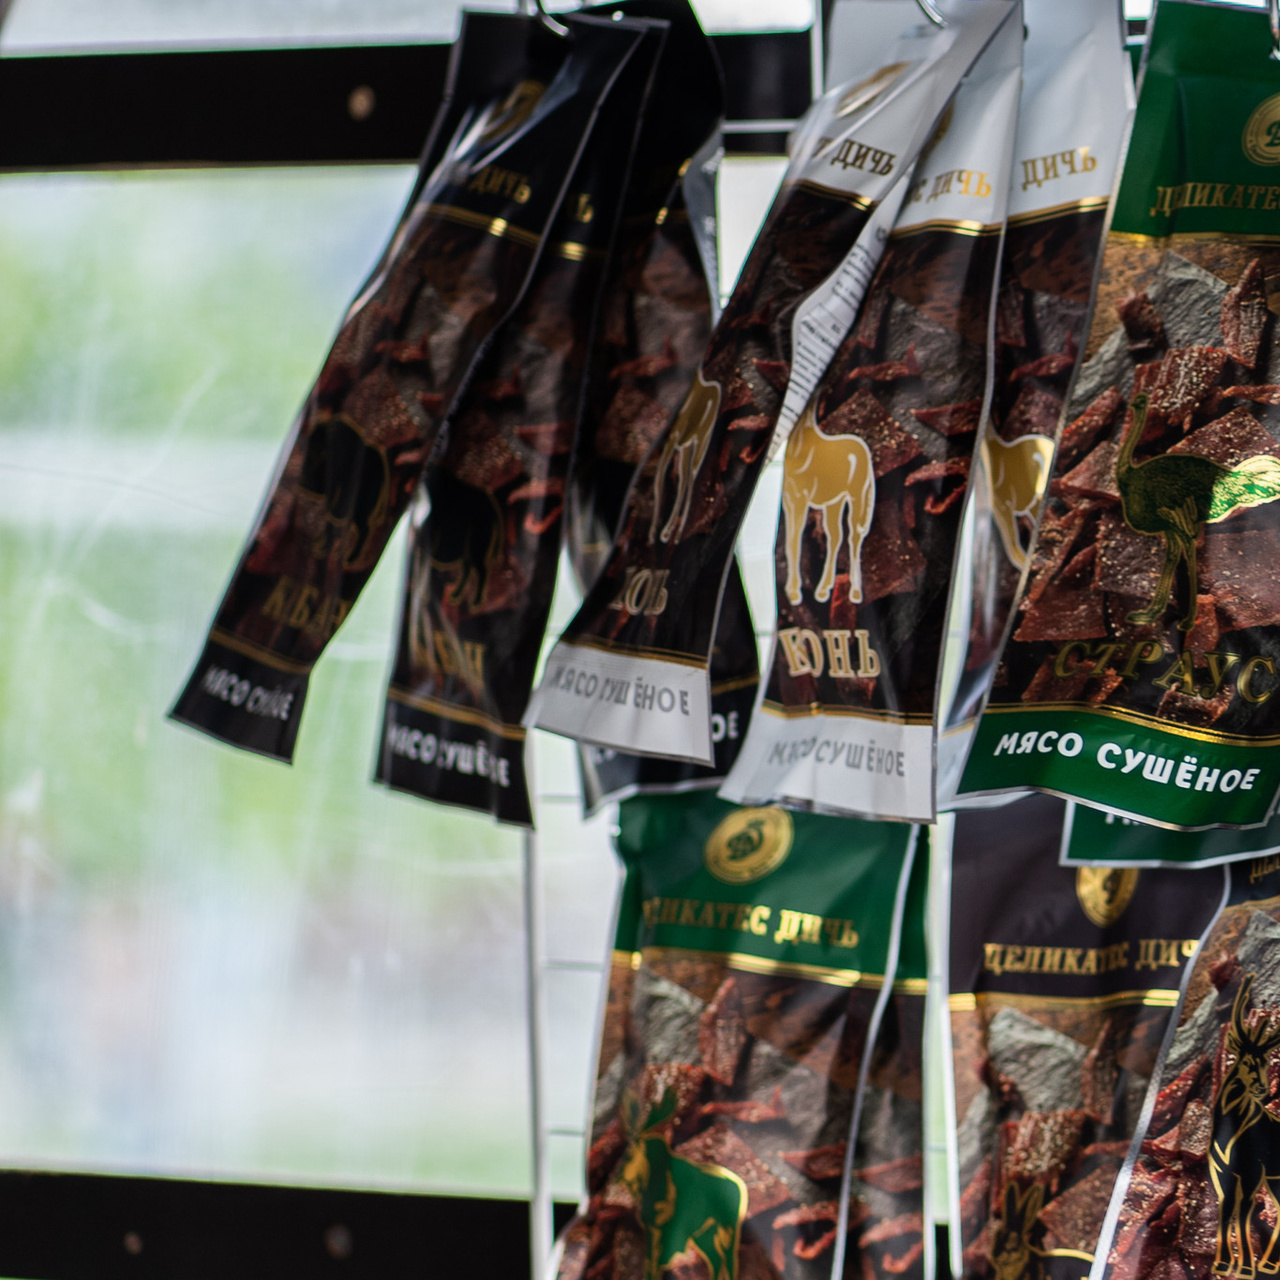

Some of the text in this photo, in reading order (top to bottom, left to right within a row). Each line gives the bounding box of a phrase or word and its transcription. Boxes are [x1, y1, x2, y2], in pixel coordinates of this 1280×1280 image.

[832, 139, 897, 177] ДИЧЬ
[1022, 147, 1098, 191] ДИЧЬ
[1054, 639, 1277, 705] СТРАУС
[993, 730, 1261, 794] МЯСО СУШЁНОЕ
